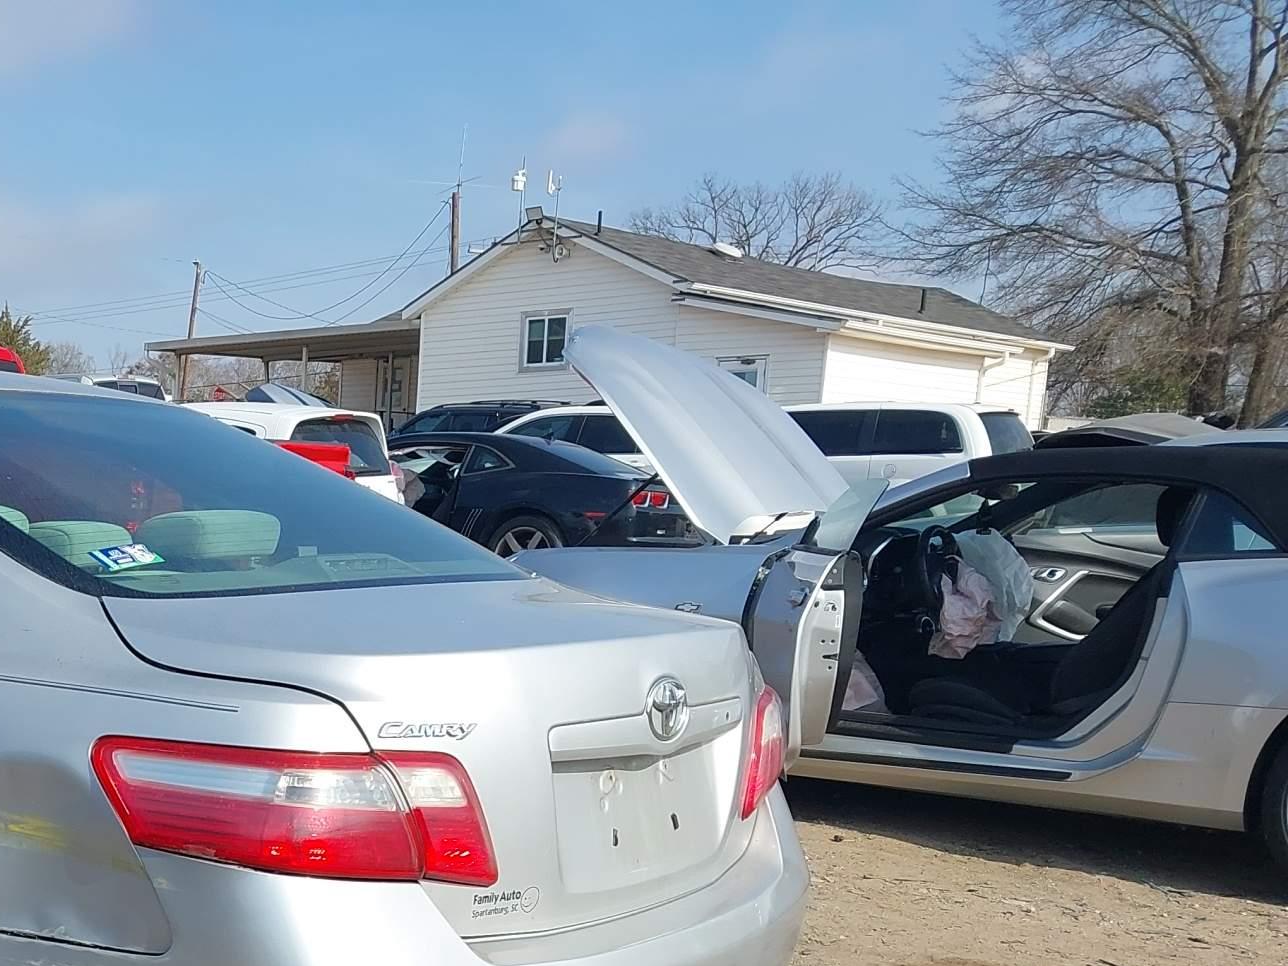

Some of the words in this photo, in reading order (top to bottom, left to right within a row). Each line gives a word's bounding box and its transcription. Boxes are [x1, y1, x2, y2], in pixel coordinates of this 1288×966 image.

[377, 721, 478, 741] CAMRY
[473, 893, 499, 905] Family
[501, 890, 522, 902] Auto
